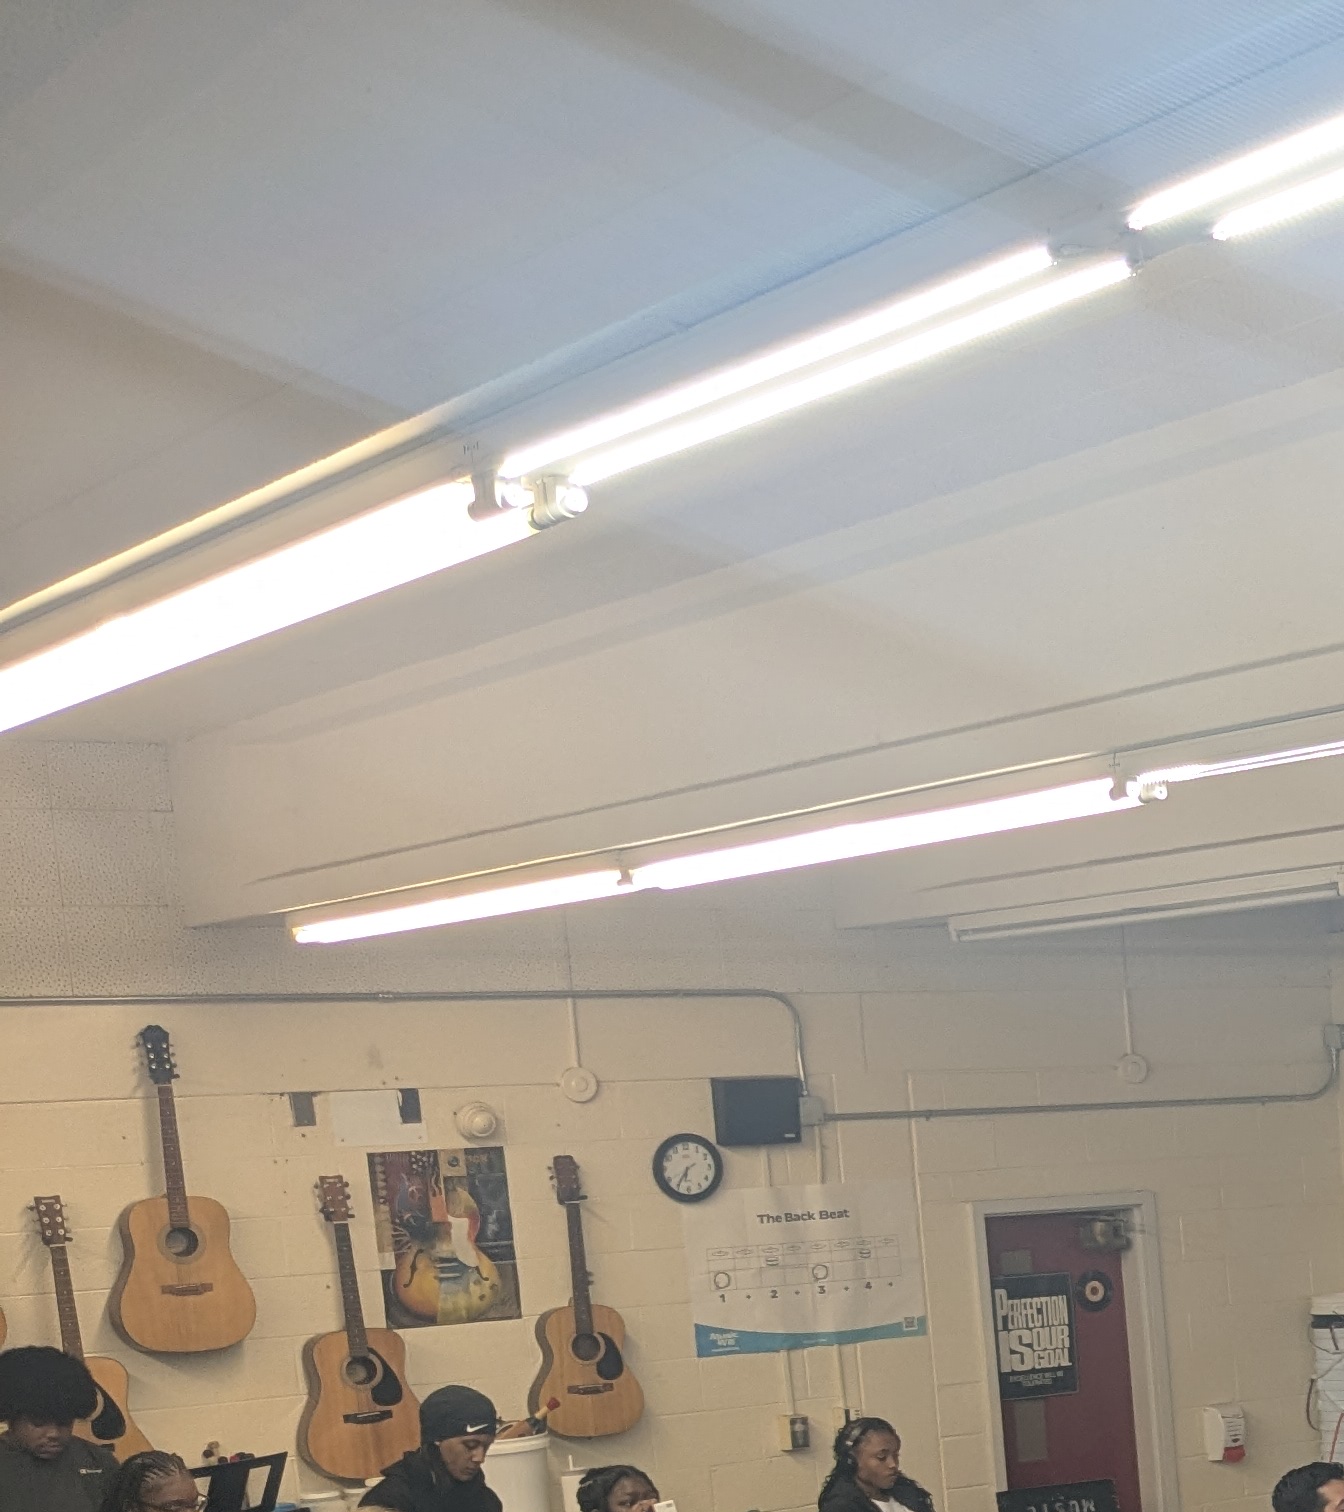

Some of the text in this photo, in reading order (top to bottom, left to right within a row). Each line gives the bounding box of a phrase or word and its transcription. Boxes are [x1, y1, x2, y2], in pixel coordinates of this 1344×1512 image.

[757, 1209, 850, 1225] The Back Beat
[993, 1288, 1069, 1331] PERFECTION
[998, 1325, 1070, 1373] IS OUR
[1034, 1347, 1073, 1370] GOAL
